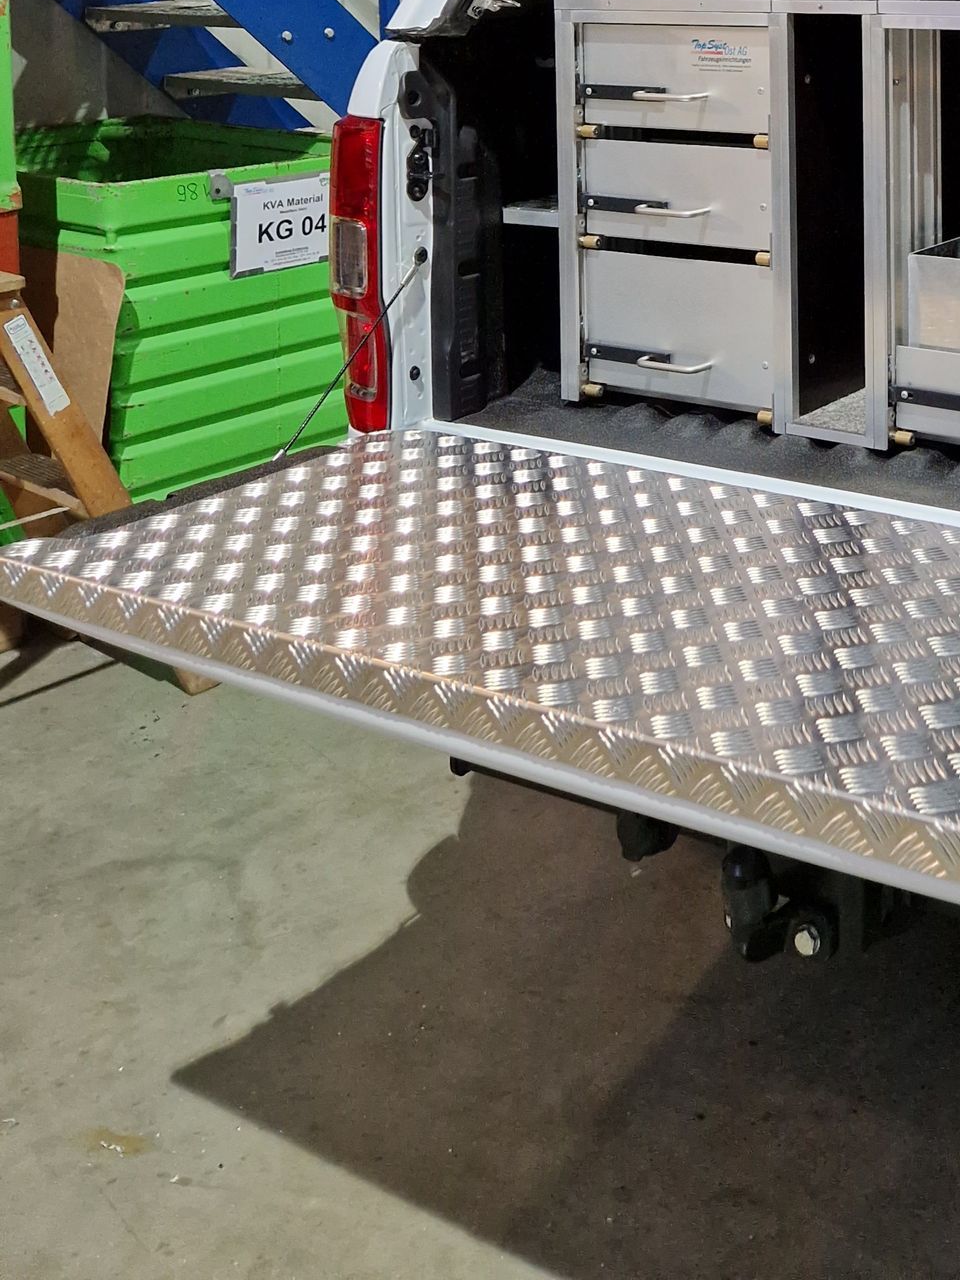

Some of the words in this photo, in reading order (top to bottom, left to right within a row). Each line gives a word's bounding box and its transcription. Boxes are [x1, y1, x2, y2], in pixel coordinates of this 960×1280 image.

[262, 200, 284, 210] KVA
[287, 193, 323, 207] Material
[258, 219, 293, 244] KG
[302, 213, 327, 236] 04
